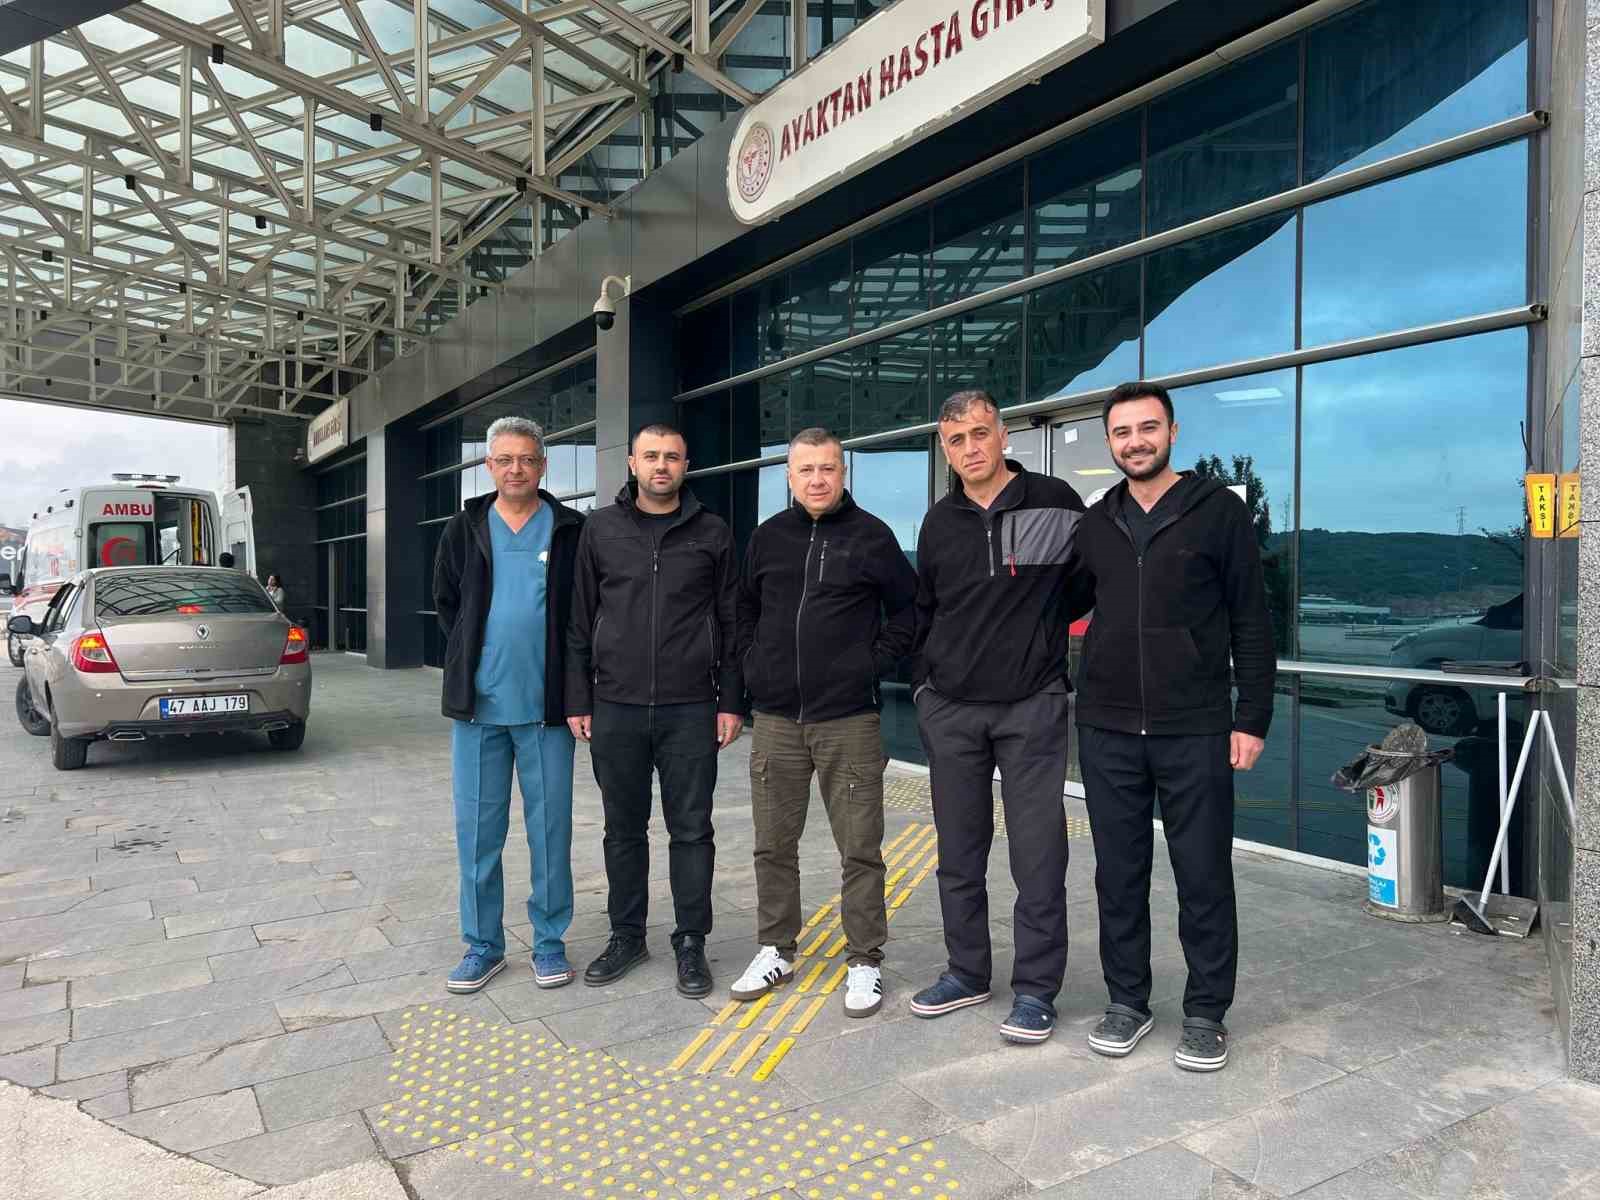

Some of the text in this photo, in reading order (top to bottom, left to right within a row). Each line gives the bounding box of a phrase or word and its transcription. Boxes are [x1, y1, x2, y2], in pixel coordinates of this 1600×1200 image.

[780, 65, 873, 162] AYAKTAN
[879, 10, 963, 101] HASTA
[102, 503, 153, 516] AMBU
[170, 700, 185, 713] 47
[193, 699, 216, 712] AAJ
[225, 696, 246, 710] 179
